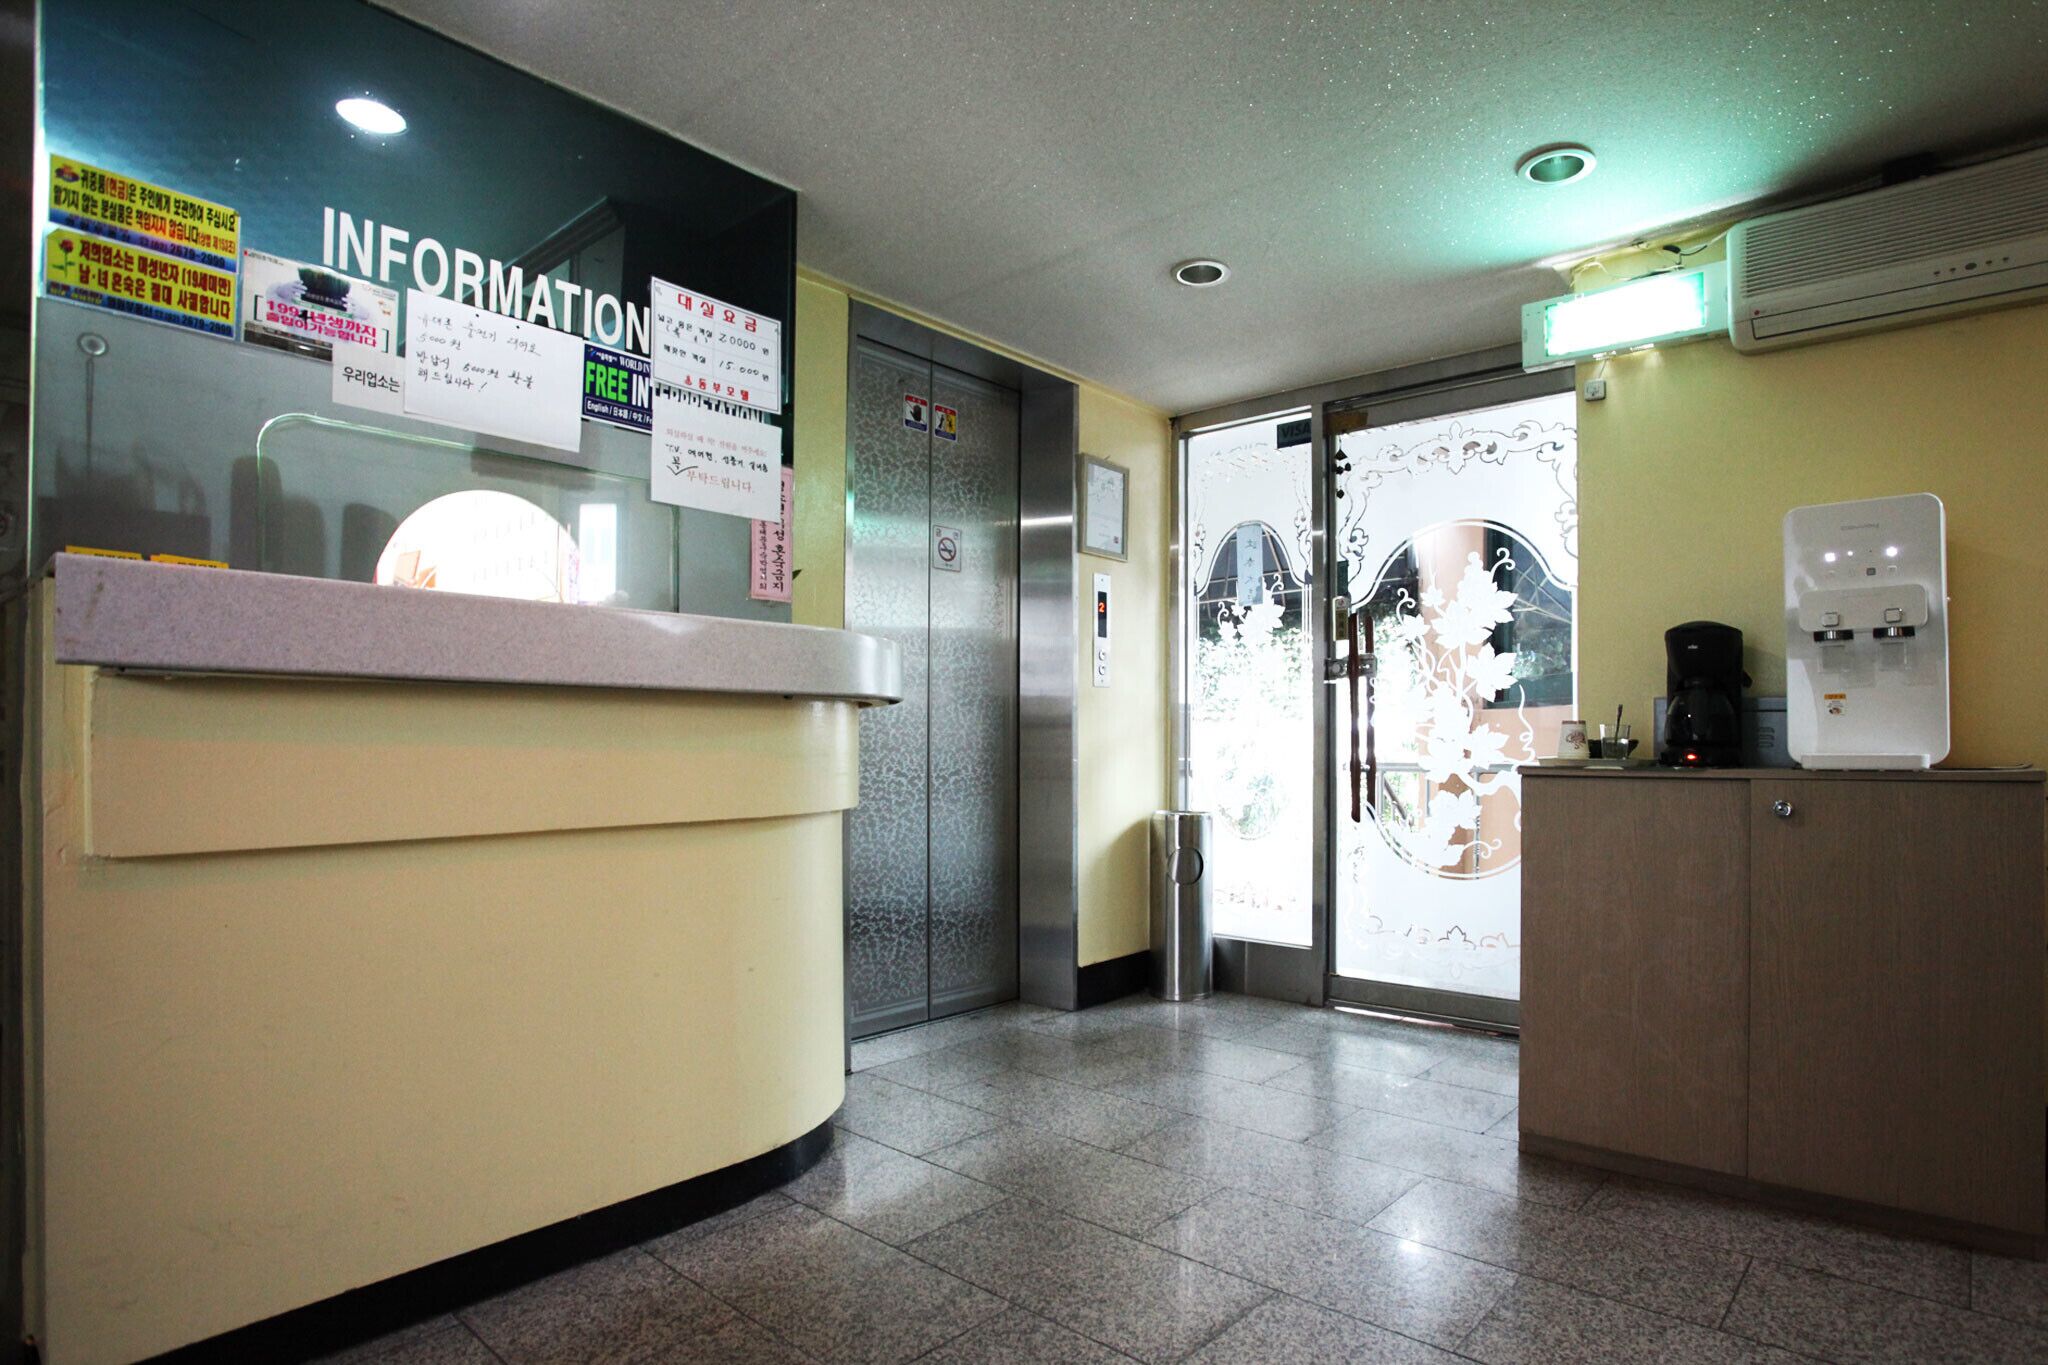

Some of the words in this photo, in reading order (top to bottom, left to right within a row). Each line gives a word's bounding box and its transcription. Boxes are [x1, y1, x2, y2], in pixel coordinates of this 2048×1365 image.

[80, 239, 134, 272] 저희업소는
[138, 255, 179, 284] 미성년자
[182, 268, 231, 297] (19세미만)
[323, 207, 650, 354] INFORMATION
[112, 272, 146, 299] 혼숙은
[151, 282, 172, 305] 절대
[177, 289, 230, 320] 사절합니다
[342, 366, 400, 392] 우리업소는
[619, 356, 642, 372] WORLD
[585, 361, 628, 403] FREE
[1282, 422, 1312, 438] VISA
[1098, 602, 1105, 613] 2
